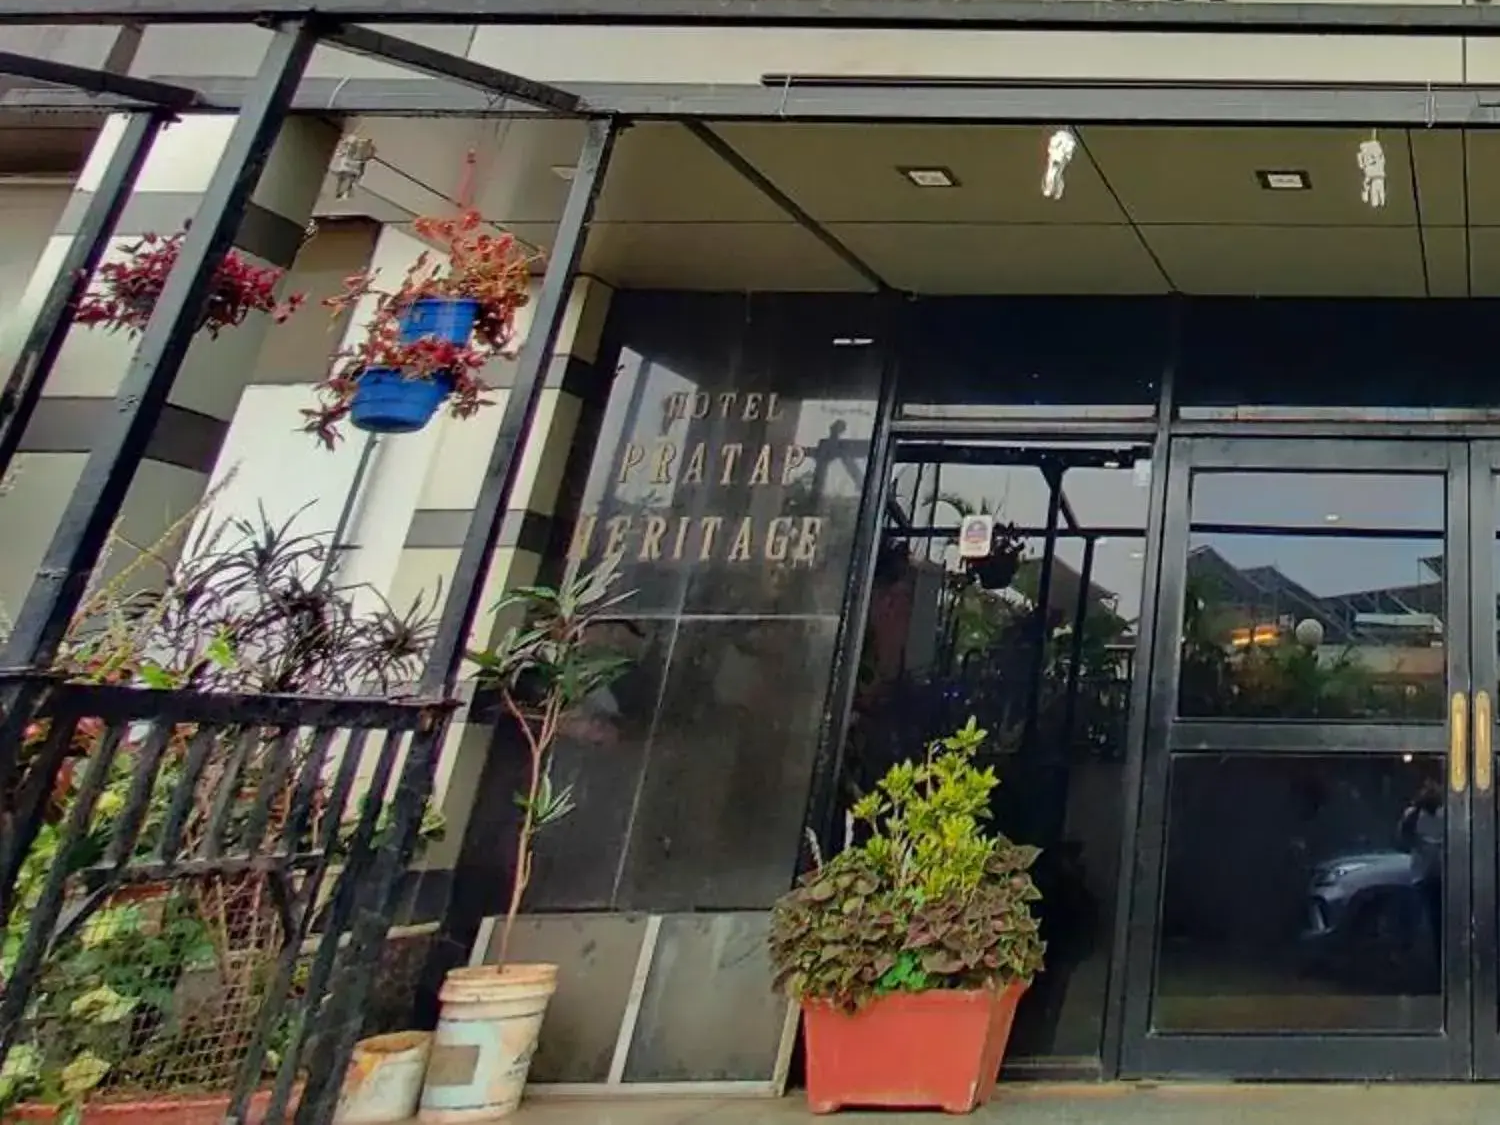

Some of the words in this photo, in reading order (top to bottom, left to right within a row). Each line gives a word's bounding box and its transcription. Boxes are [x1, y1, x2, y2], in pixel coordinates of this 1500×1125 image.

[666, 391, 784, 422] HOTEL
[617, 442, 806, 487] PRATAP
[566, 515, 824, 564] HERITAGE
